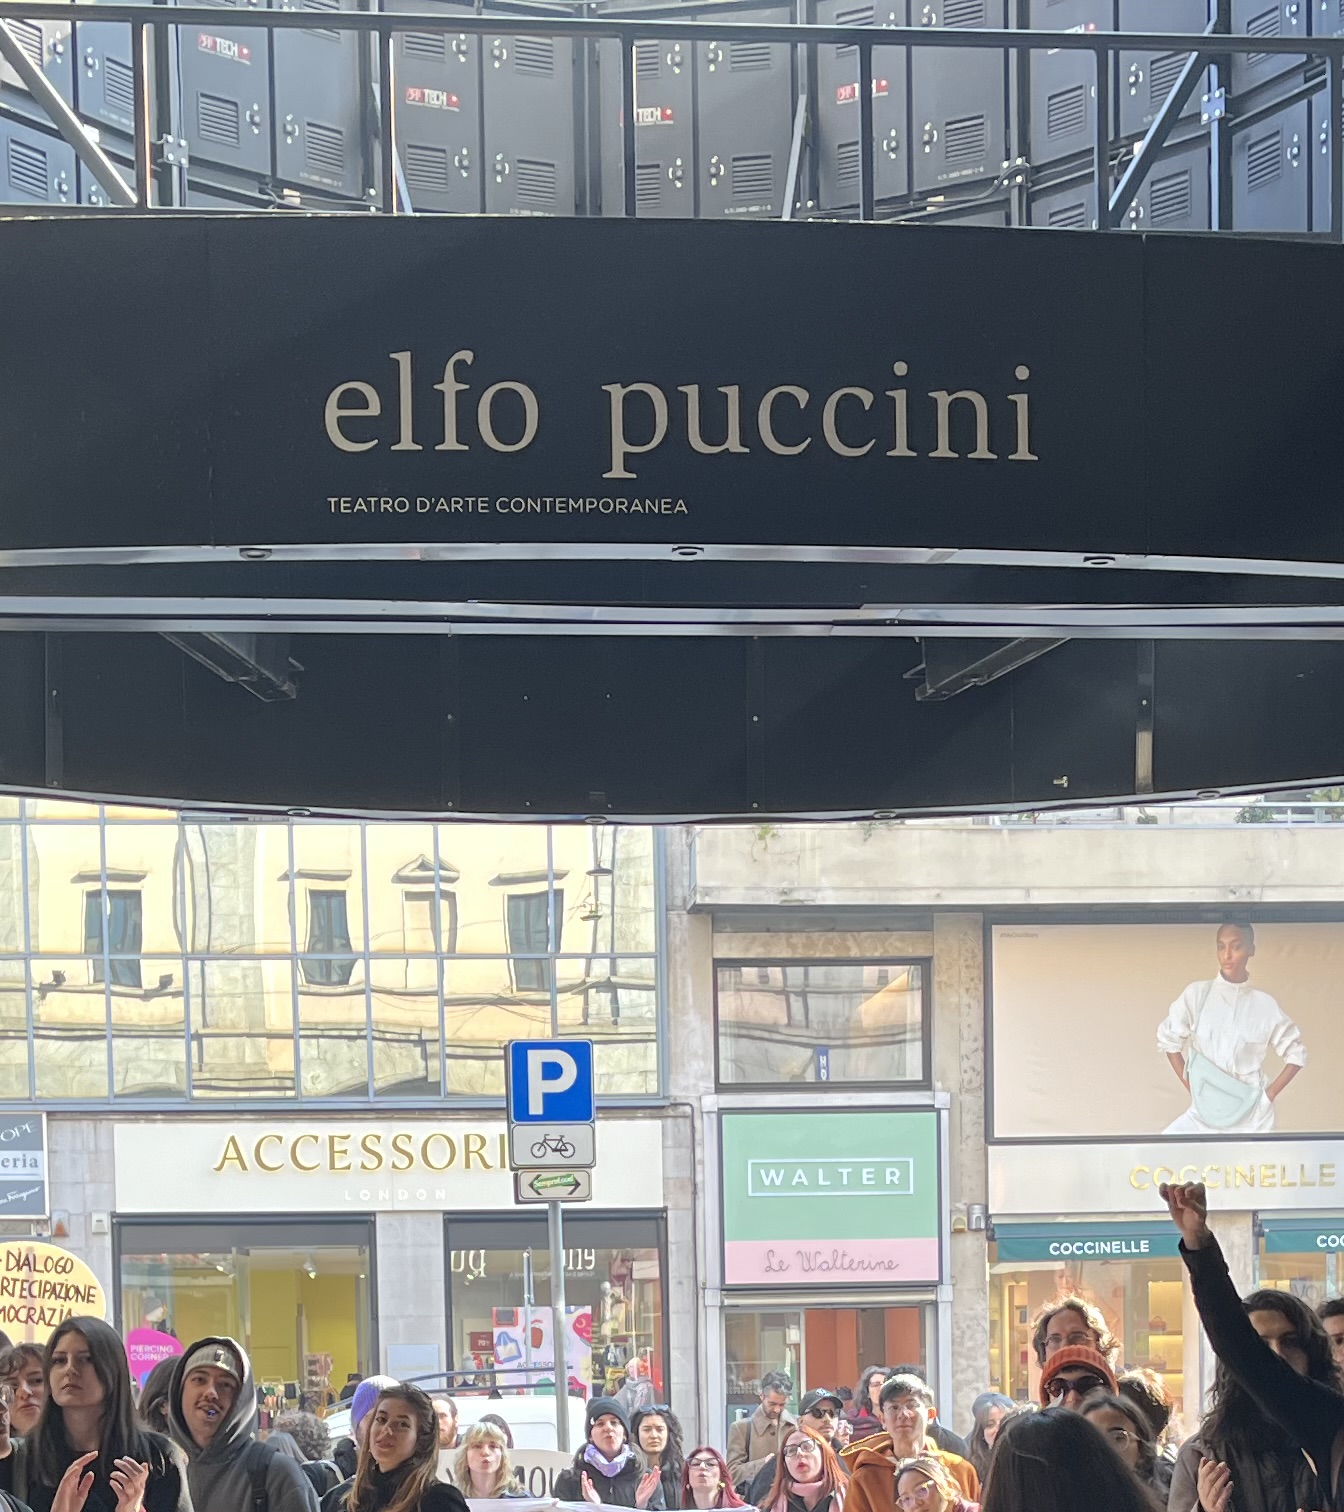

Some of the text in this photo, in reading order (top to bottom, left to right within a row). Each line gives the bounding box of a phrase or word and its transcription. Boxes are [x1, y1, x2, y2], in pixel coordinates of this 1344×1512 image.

[423, 89, 447, 106] TECH
[324, 350, 1039, 479] elfo puccini
[327, 496, 689, 515] TEATRO D'ARTE CONTEMPORANEA
[526, 1049, 578, 1116] P
[760, 1167, 901, 1186] WALTER
[1129, 1163, 1337, 1190] COCCINELLE
[344, 1188, 447, 1201] LONDON
[1049, 1240, 1150, 1256] COCCINELLE
[5, 1249, 74, 1274] DIALOGO
[764, 1248, 900, 1273] Le Walterine
[130, 1345, 174, 1353] PIERCING
